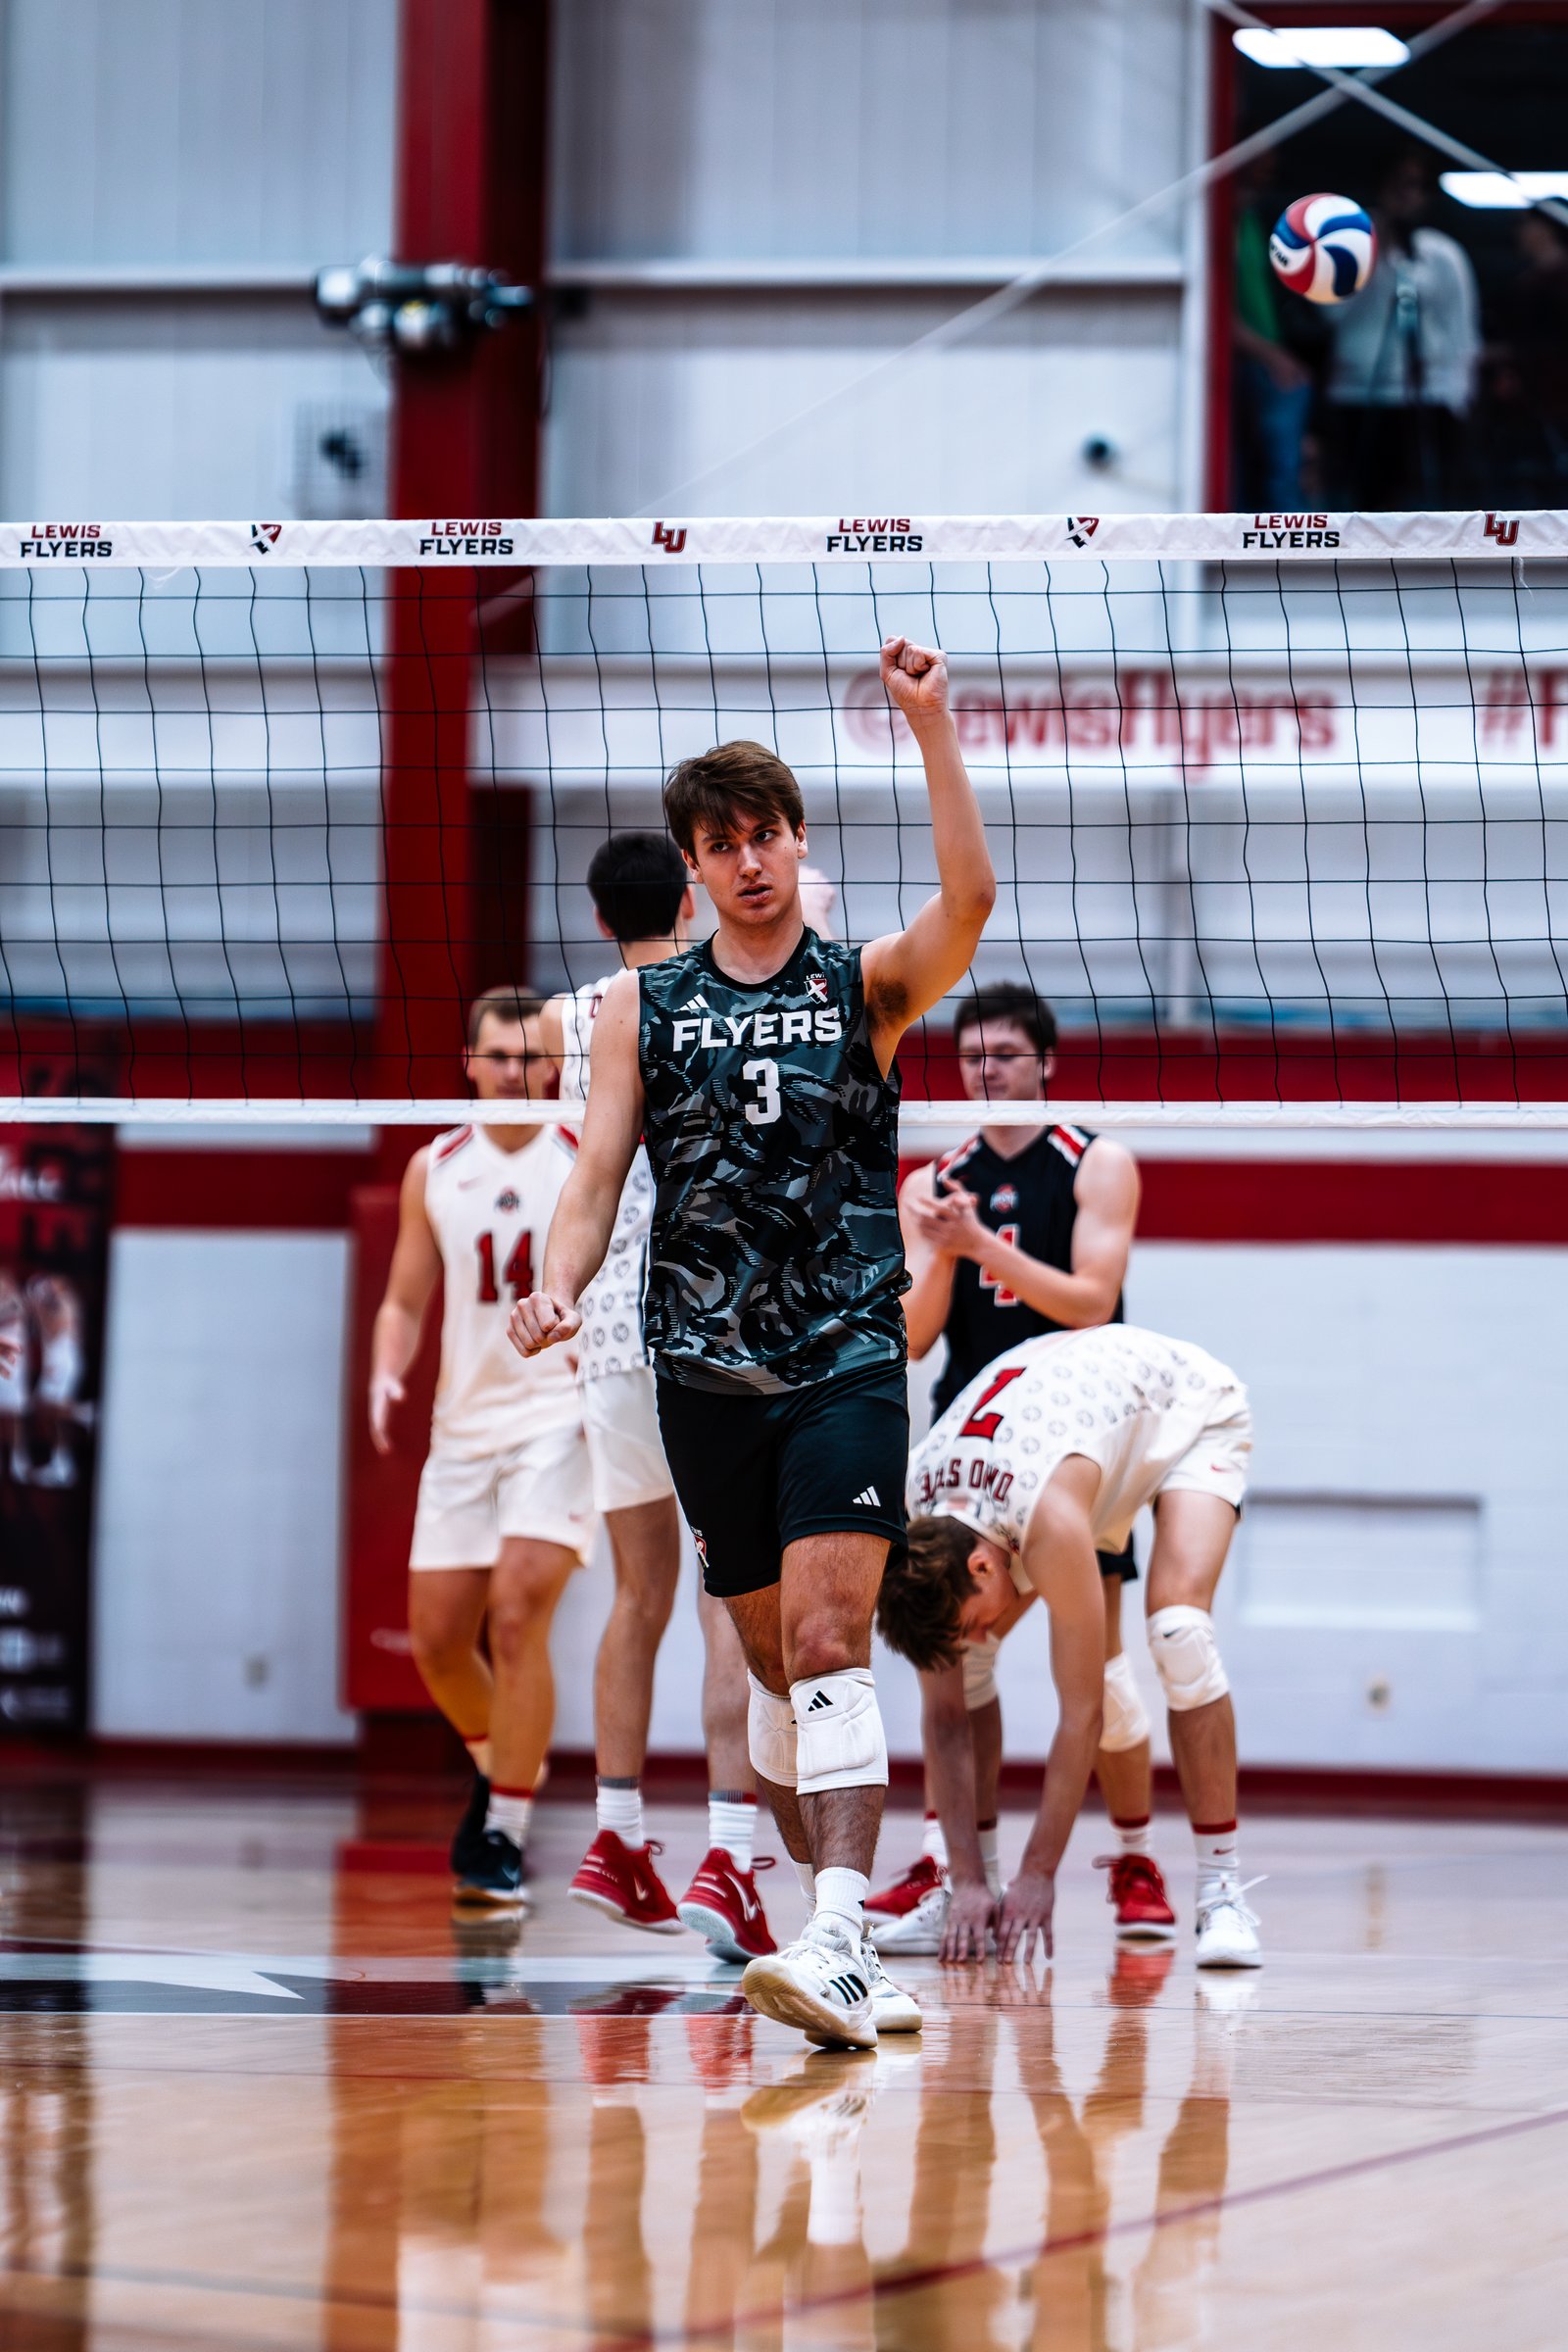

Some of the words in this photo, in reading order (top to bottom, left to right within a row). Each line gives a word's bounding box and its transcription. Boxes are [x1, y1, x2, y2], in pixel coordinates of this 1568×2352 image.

[430, 521, 502, 536] LEWIS
[839, 518, 911, 533] LEWIS
[1254, 514, 1328, 529] LEWIS
[1484, 514, 1519, 547] LU
[30, 524, 101, 538] LEWIS
[651, 520, 686, 554] LU
[20, 541, 114, 559] FLYERS
[418, 539, 514, 557] FLYERS
[825, 536, 924, 554] FLYERS
[1243, 532, 1341, 550] FLYERS
[672, 1007, 842, 1053] FLYERS
[742, 1058, 782, 1125] 3
[475, 1230, 535, 1304] 14
[956, 1367, 1027, 1443] 7
